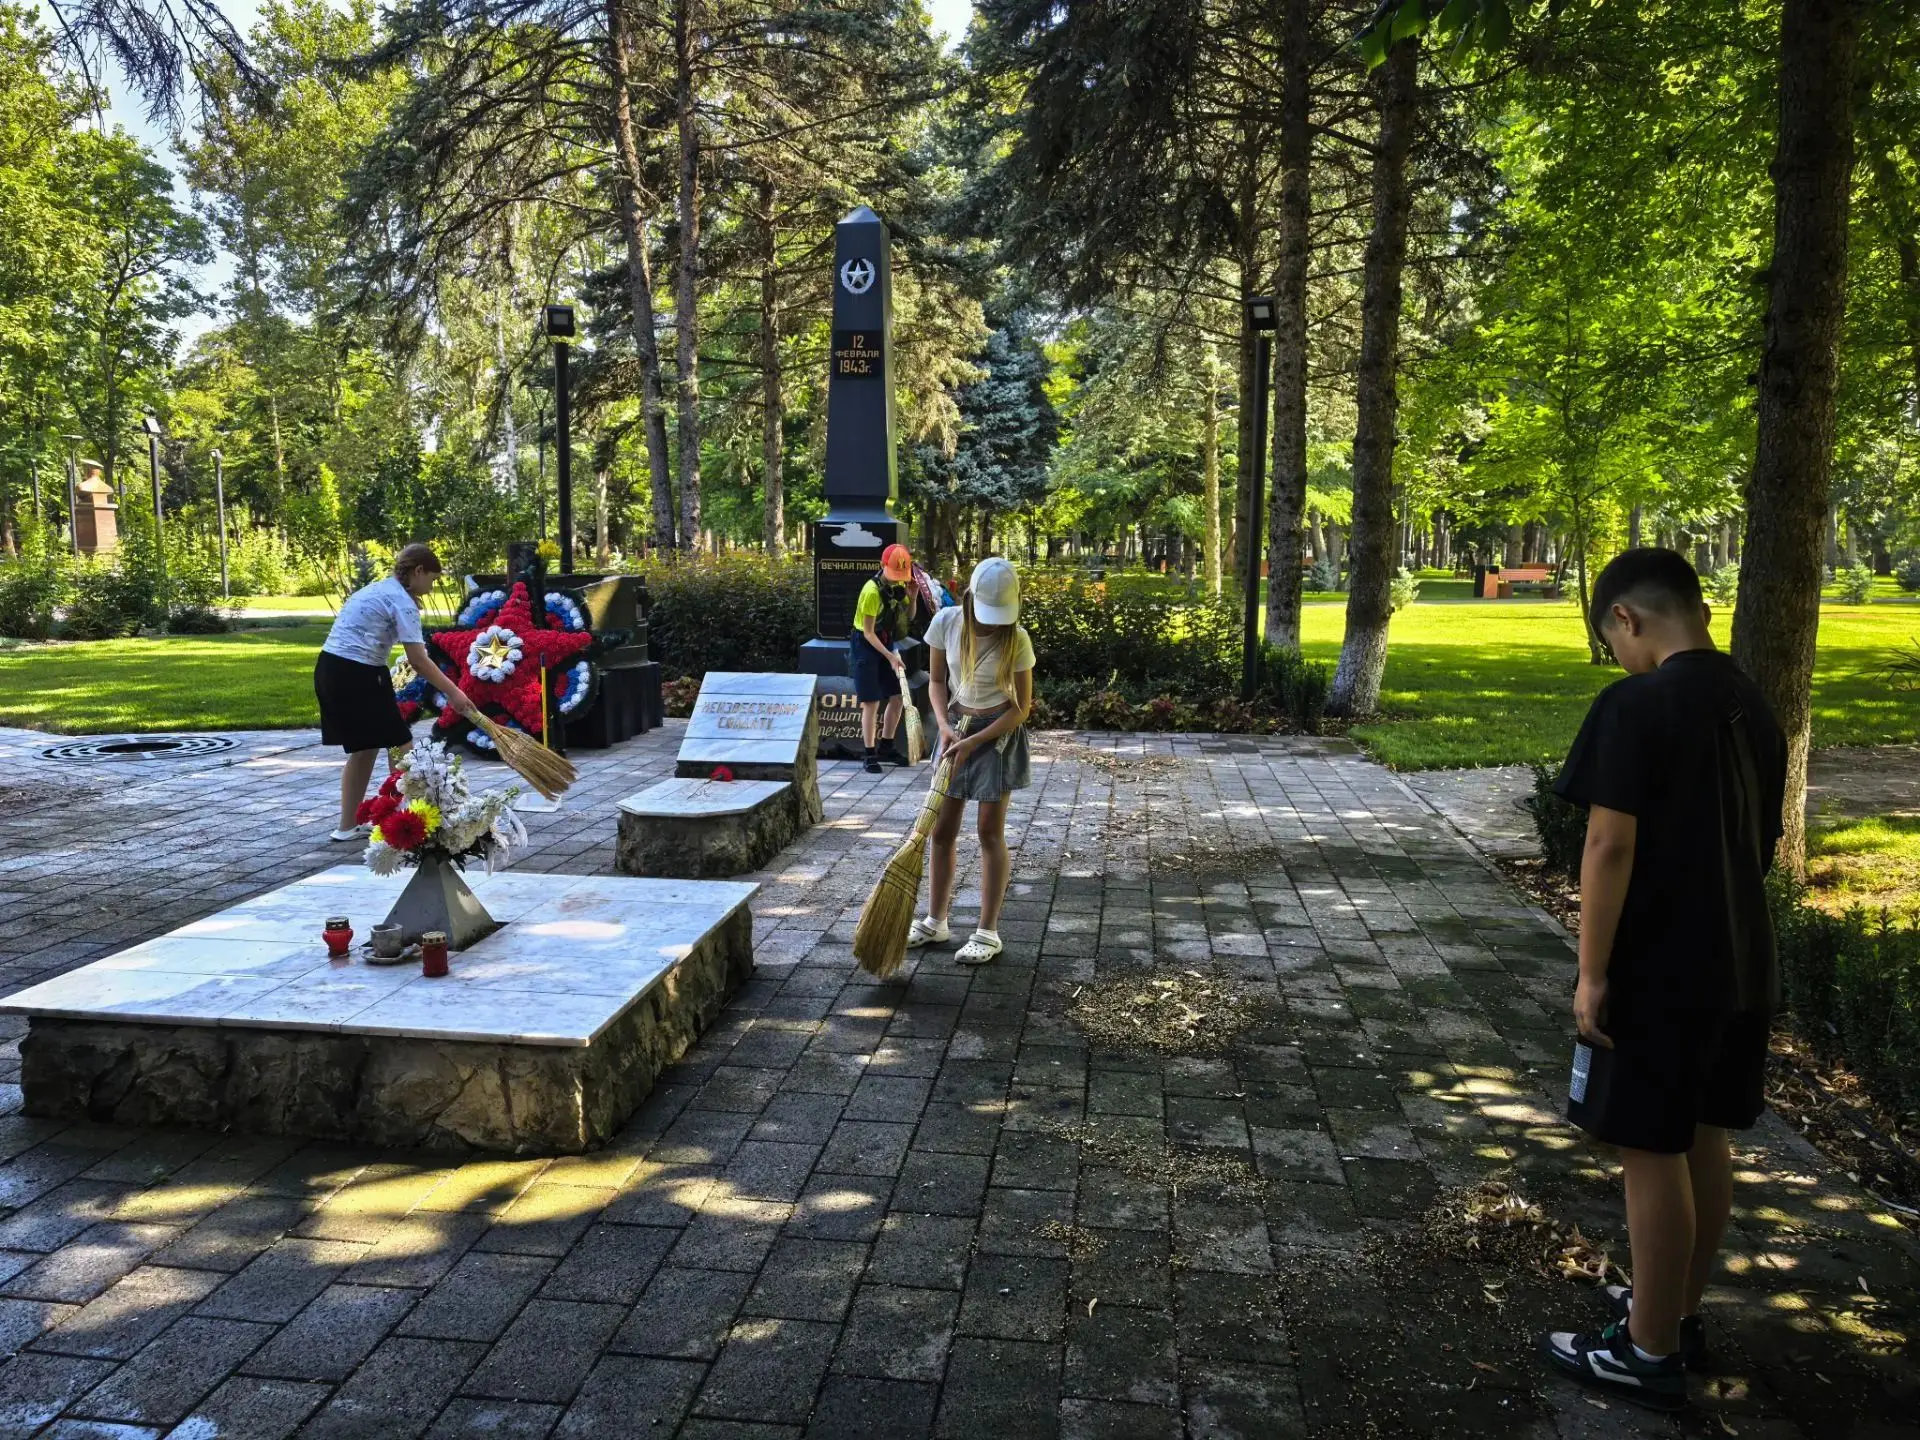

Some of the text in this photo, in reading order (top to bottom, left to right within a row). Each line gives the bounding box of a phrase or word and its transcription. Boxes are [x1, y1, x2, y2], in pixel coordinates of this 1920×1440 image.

[853, 335, 864, 348] 12
[834, 350, 880, 358] ФЕВРАЛЯ
[840, 360, 872, 373] 1943г.
[821, 562, 880, 571] ВЕЧНАЯ ПАМЯ
[702, 701, 799, 716] НЕИЗВЕСТНОМУ
